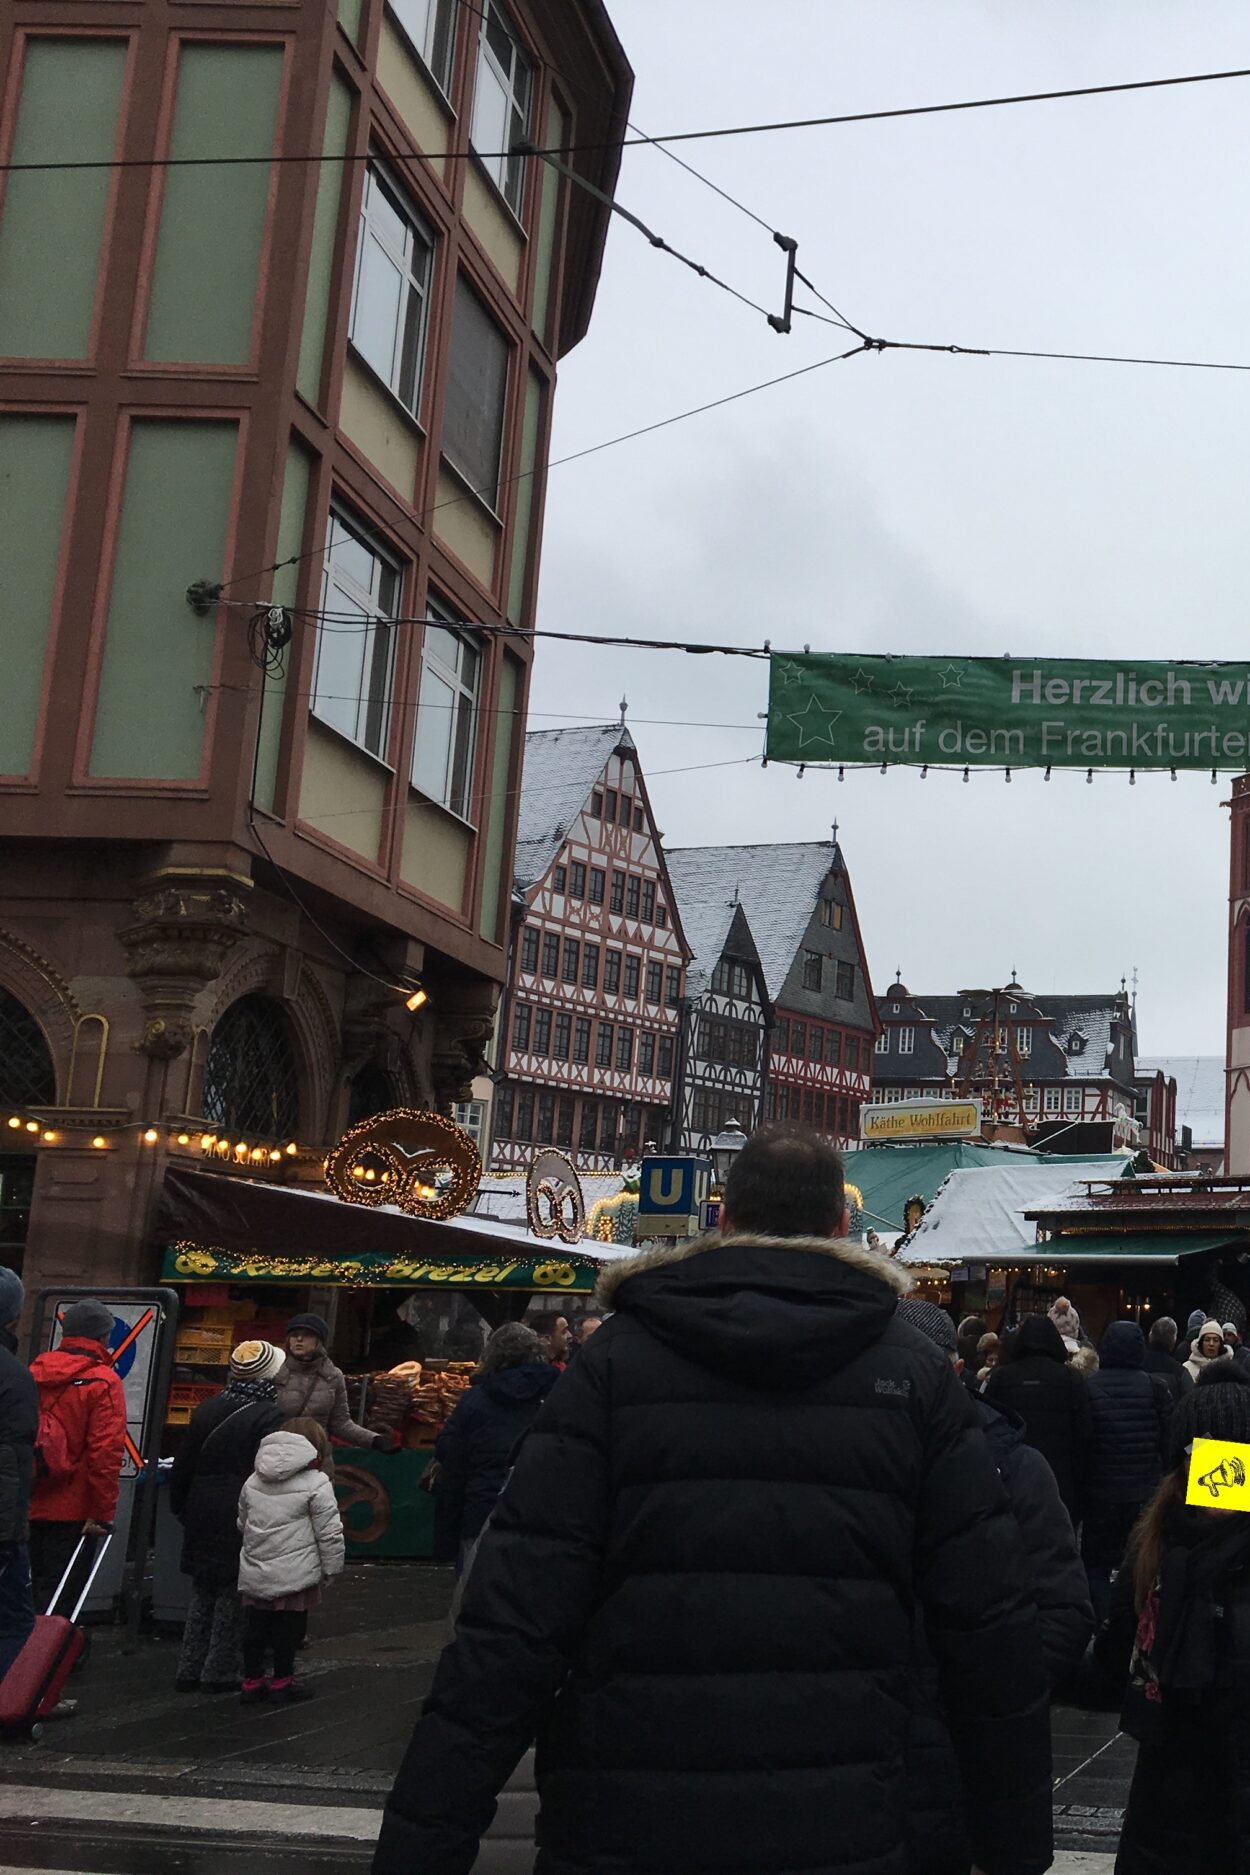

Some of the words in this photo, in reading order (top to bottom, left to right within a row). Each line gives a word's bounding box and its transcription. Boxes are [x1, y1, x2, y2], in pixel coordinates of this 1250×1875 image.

[1011, 670, 1191, 706] Herzlich
[863, 719, 926, 753] auf
[938, 720, 1024, 754] dem
[870, 1115, 905, 1130] Käthe
[910, 1111, 971, 1127] Wohlfahrt
[649, 1168, 684, 1206] U
[694, 1169, 708, 1207] U
